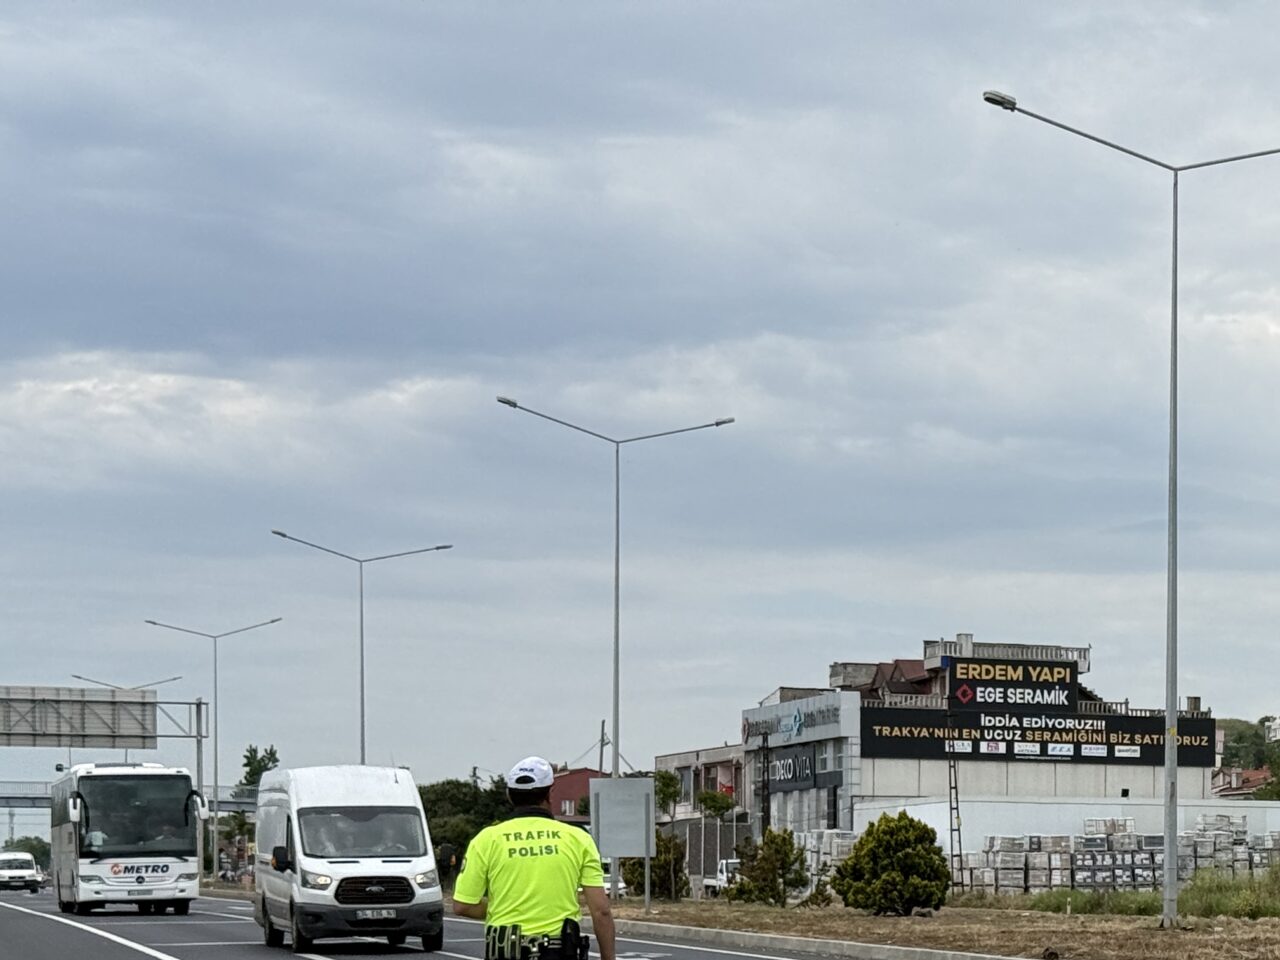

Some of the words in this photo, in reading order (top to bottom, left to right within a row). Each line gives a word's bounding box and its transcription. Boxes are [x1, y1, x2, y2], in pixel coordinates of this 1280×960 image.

[956, 663, 1023, 681] ERDEM
[1028, 666, 1071, 683] YAPI
[976, 686, 1004, 703] EGE
[1007, 685, 1069, 706] SERAMİK
[980, 713, 1020, 728] İDDİA
[1022, 715, 1106, 730] EDİYORUZ!!!
[962, 729, 980, 740] EN
[984, 729, 1022, 741] UCUZ
[1025, 730, 1107, 743] SERAMİĞİNİ
[1109, 731, 1131, 744] BİZ
[1134, 733, 1209, 746] SATIORUZ
[776, 758, 794, 781] DECO
[123, 864, 170, 874] METRO
